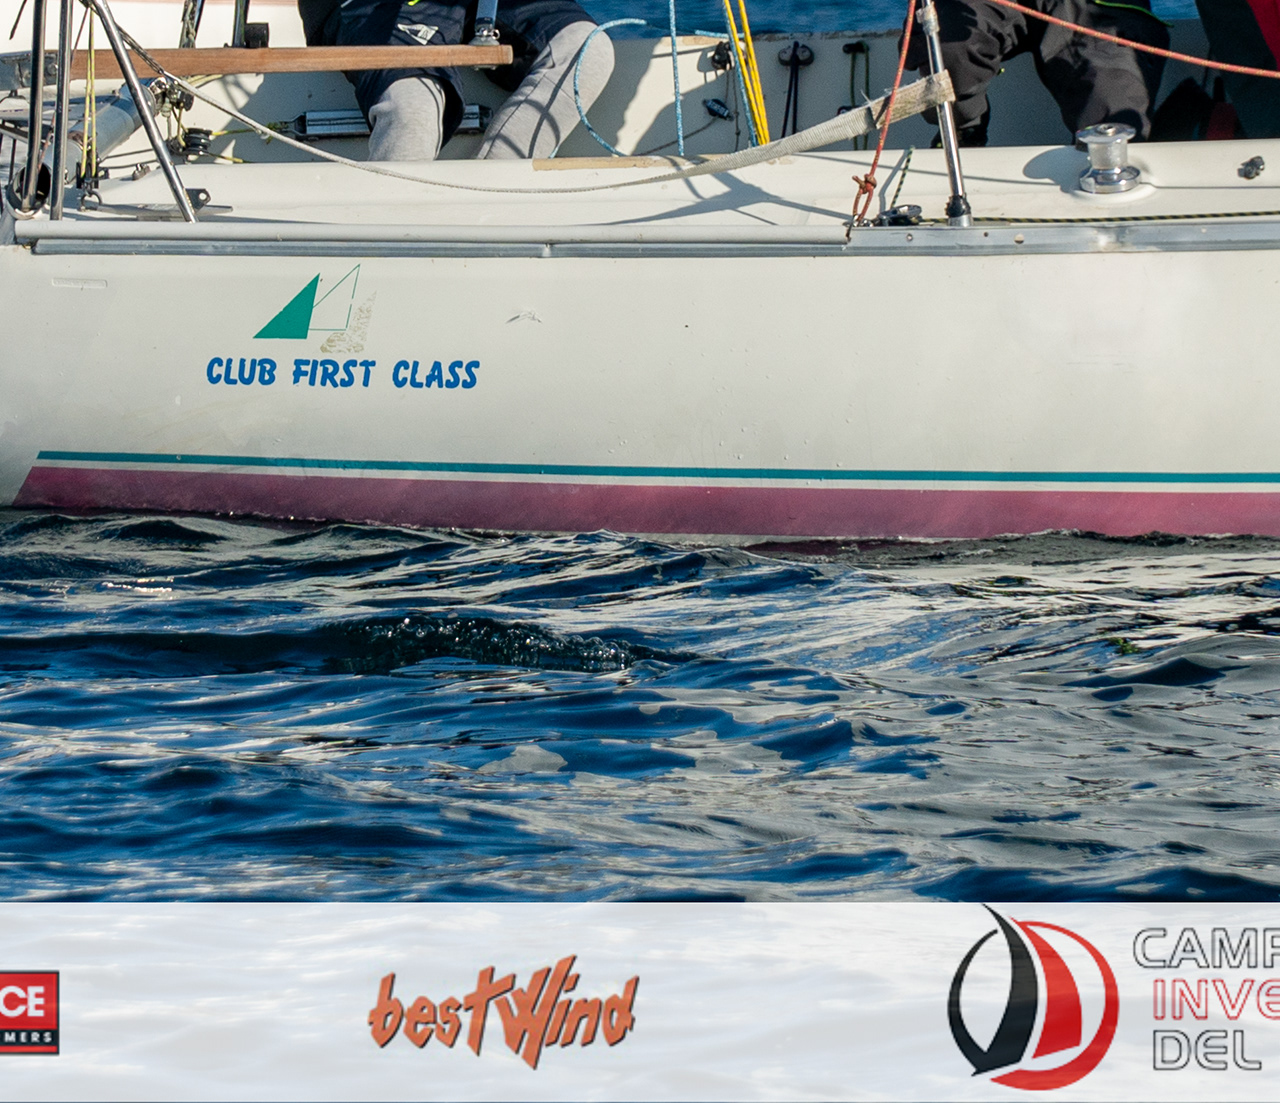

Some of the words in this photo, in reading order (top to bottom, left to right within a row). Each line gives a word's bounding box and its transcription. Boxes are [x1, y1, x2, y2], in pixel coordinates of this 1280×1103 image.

[206, 357, 277, 386] CLUB
[292, 359, 376, 388] FIRST
[392, 361, 480, 389] CLASS
